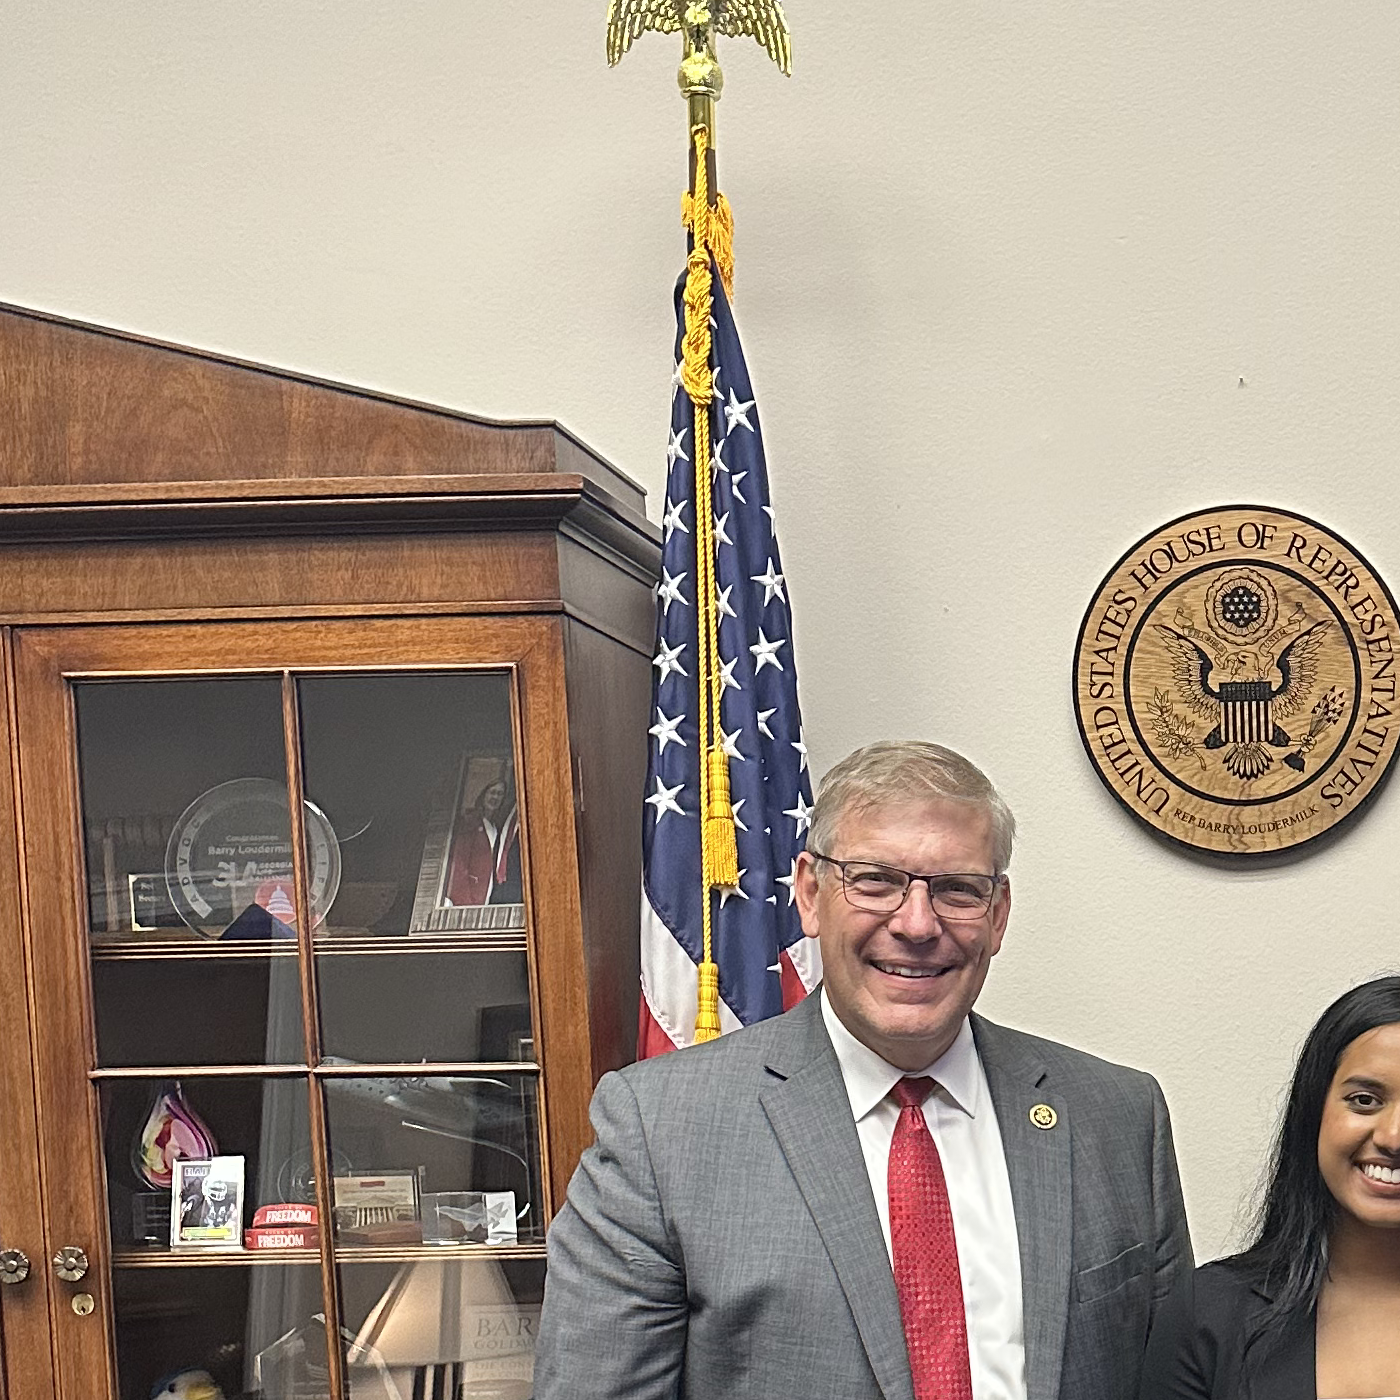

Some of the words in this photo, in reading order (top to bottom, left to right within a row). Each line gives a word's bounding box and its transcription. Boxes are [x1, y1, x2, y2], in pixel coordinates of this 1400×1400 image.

[1236, 521, 1278, 550] OF
[1128, 524, 1226, 594] HOUSE
[1089, 588, 1137, 699] STATES
[1284, 531, 1397, 809] REPRESENTATIVES
[1093, 705, 1170, 817] UNITED
[1198, 818, 1242, 835] BARRY
[1242, 803, 1320, 835] LOUDERMILK
[208, 846, 237, 857] Barry
[238, 842, 294, 855] Loudermil
[265, 1209, 312, 1224] FREEDOM
[257, 1233, 305, 1248] FREEDOM
